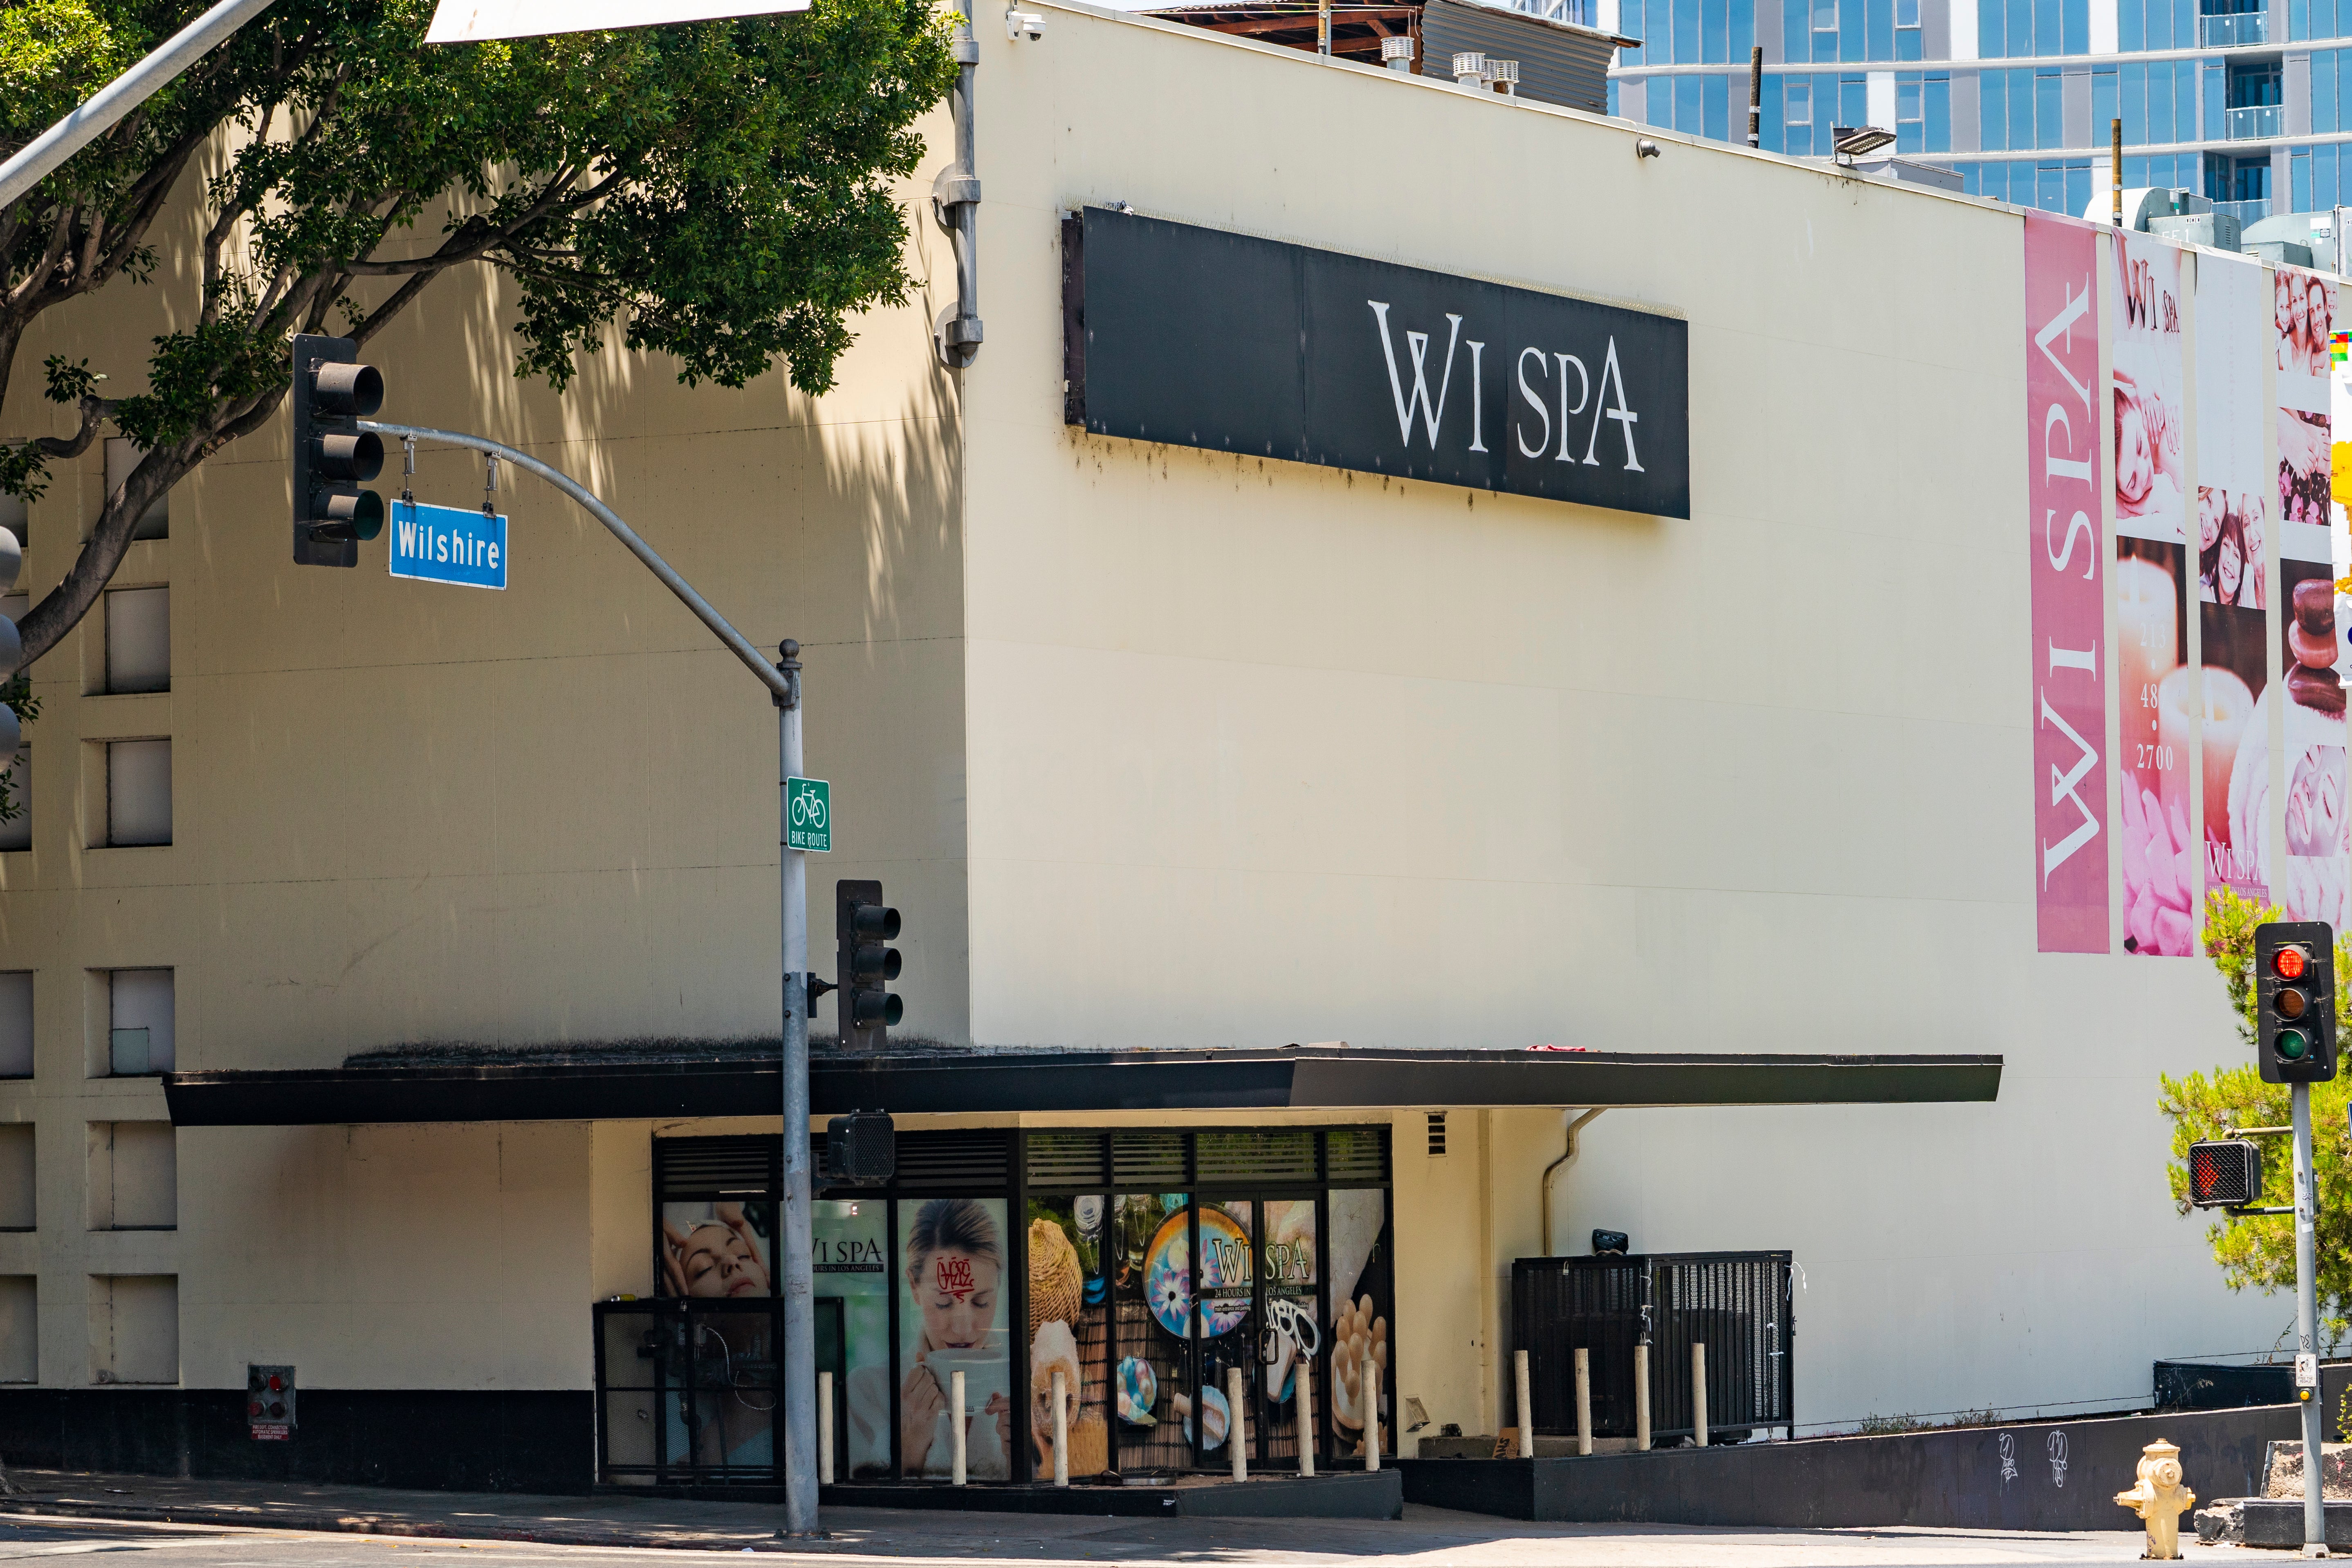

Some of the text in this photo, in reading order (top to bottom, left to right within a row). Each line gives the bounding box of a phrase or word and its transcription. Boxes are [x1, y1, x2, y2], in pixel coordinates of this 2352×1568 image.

[2162, 290, 2180, 333] SPA
[1368, 300, 1644, 472] WI SPA
[399, 520, 499, 569] Wilshire
[2034, 271, 2100, 892] WI SPA
[2137, 743, 2173, 771] 2700
[792, 830, 827, 847] BIKE ROUTE
[2205, 841, 2232, 878] WI
[2238, 887, 2246, 896] LOS
[2247, 888, 2267, 898] ANGELES
[812, 1238, 884, 1263] I SPA
[1212, 1238, 1309, 1283] WI SPA
[1215, 1289, 1221, 1297] 24
[1223, 1288, 1243, 1297] HOURS
[1244, 1288, 1251, 1297] IN
[1277, 1286, 1302, 1295] ANGELES
